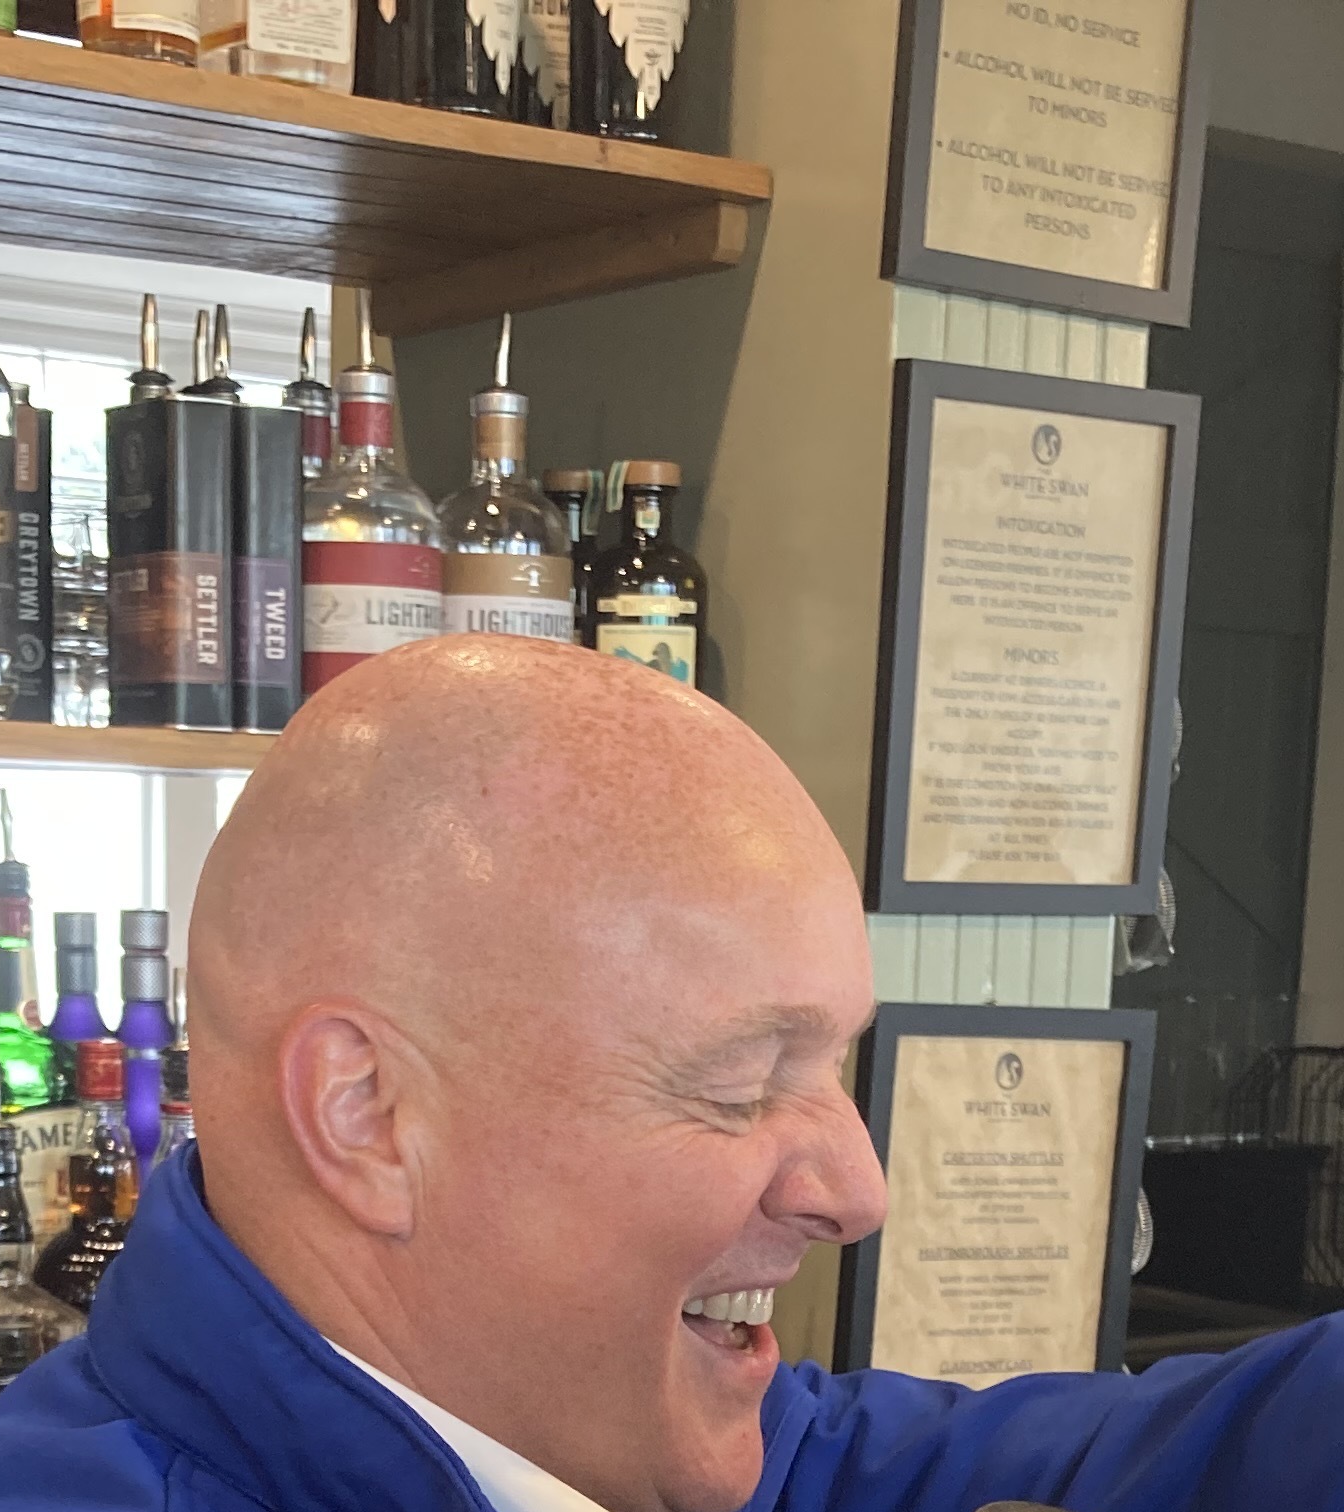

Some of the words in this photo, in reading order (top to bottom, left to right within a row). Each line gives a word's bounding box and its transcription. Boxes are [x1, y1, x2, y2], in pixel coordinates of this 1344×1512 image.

[1056, 14, 1079, 32] NO
[1081, 18, 1142, 48] SERVICE
[955, 50, 1028, 81] ALCOHOL
[1031, 66, 1066, 90] WILL
[1069, 76, 1102, 97] NOT
[1105, 82, 1123, 101] BE
[1028, 94, 1049, 115] TO
[1052, 100, 1107, 129] MINORS
[947, 139, 1022, 168] ALCOHOL
[1025, 153, 1060, 178] WILL
[1063, 163, 1095, 184] NOT
[1097, 168, 1115, 187] BE
[982, 173, 1004, 194] TO
[1007, 181, 1038, 201] ANY
[1024, 211, 1091, 240] PERSONS
[17, 511, 41, 622] GREYTOWN
[196, 572, 218, 666] SETTLER
[265, 587, 286, 660] TWEED
[963, 1100, 1007, 1117] WHITE
[1010, 1101, 1052, 1118] SWAN
